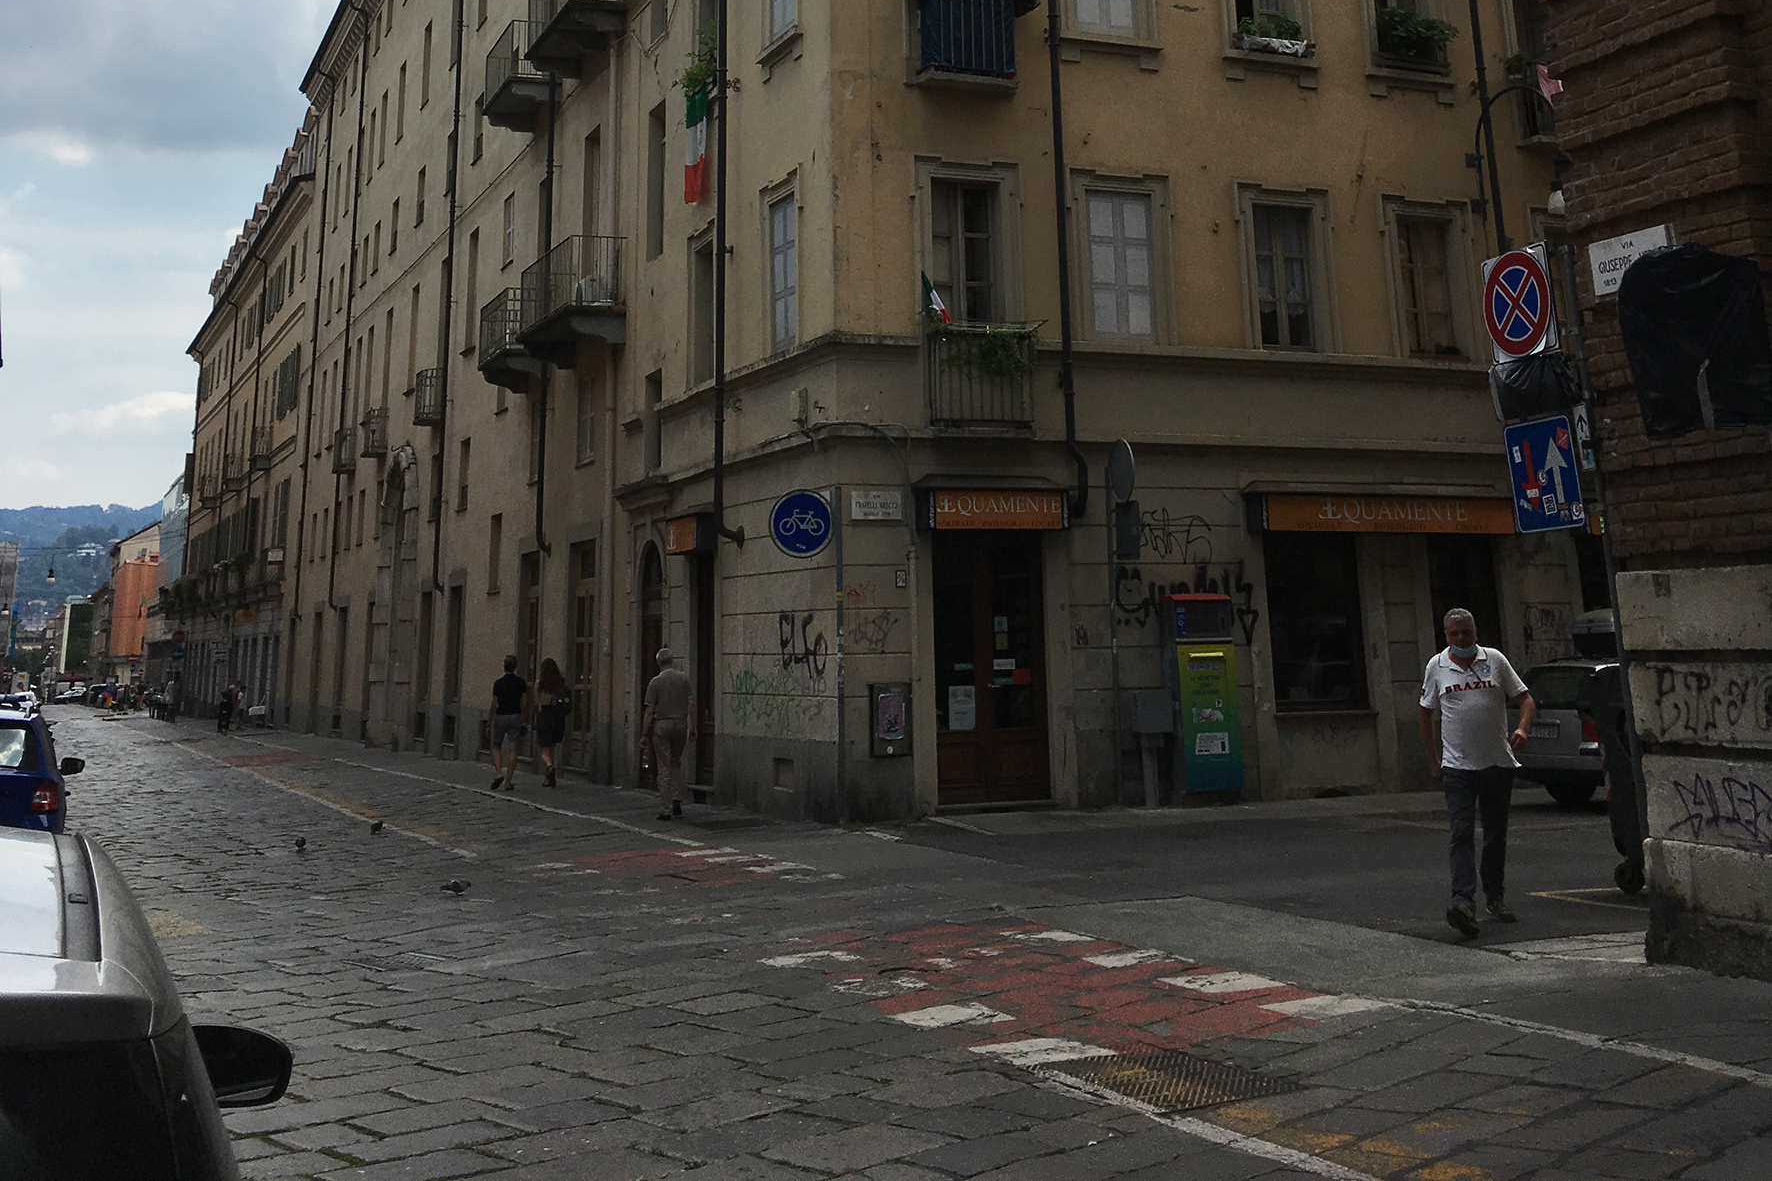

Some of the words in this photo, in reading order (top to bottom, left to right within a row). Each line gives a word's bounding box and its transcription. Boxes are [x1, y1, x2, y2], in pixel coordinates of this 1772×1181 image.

[1621, 240, 1635, 250] VIA
[1598, 254, 1633, 274] GIUSEPPE
[1603, 277, 1618, 287] 1813
[1445, 680, 1496, 694] BRAZIL
